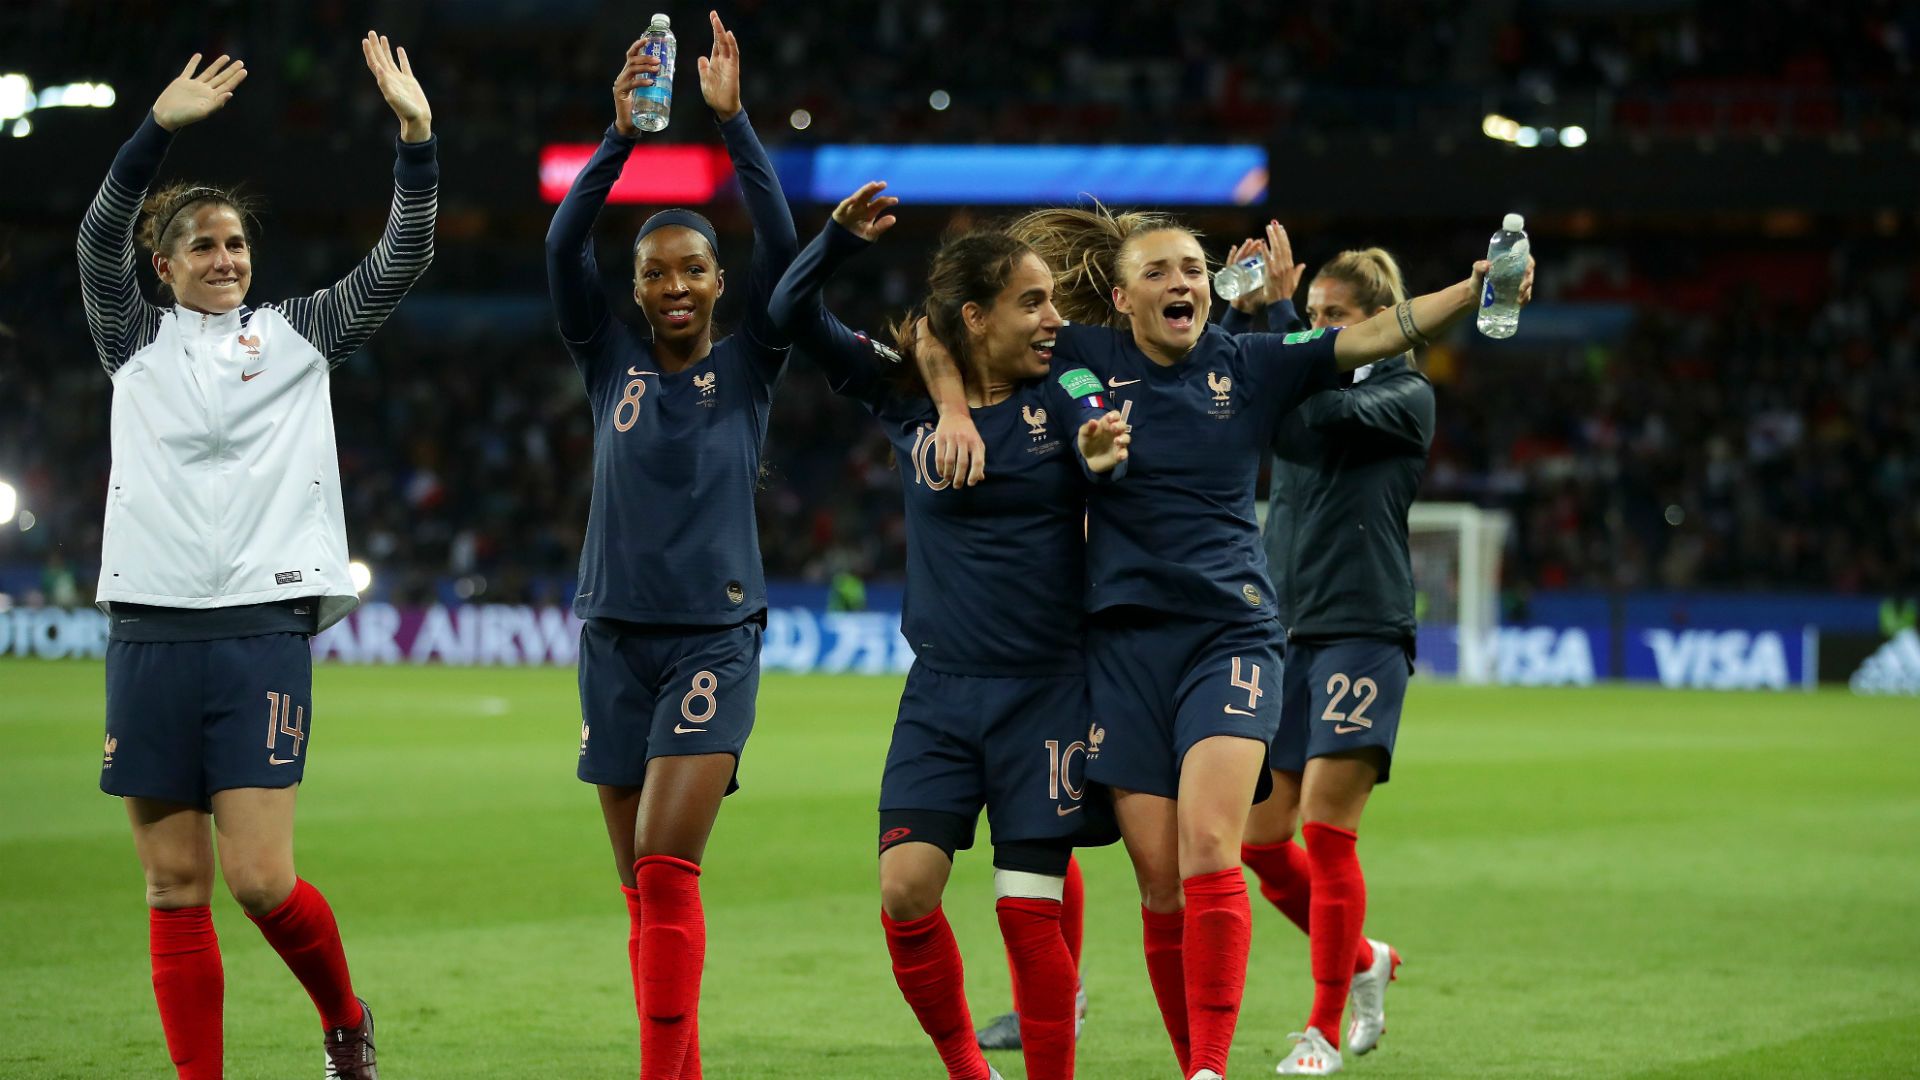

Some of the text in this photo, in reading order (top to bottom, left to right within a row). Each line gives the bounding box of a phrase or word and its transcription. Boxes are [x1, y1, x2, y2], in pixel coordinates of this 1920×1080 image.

[613, 379, 646, 433] 8
[1230, 656, 1263, 709] 4
[1642, 629, 1790, 691] VISA
[267, 691, 304, 756] 14
[680, 670, 718, 723] 8
[1321, 672, 1378, 728] 22
[1045, 740, 1086, 800] 10
